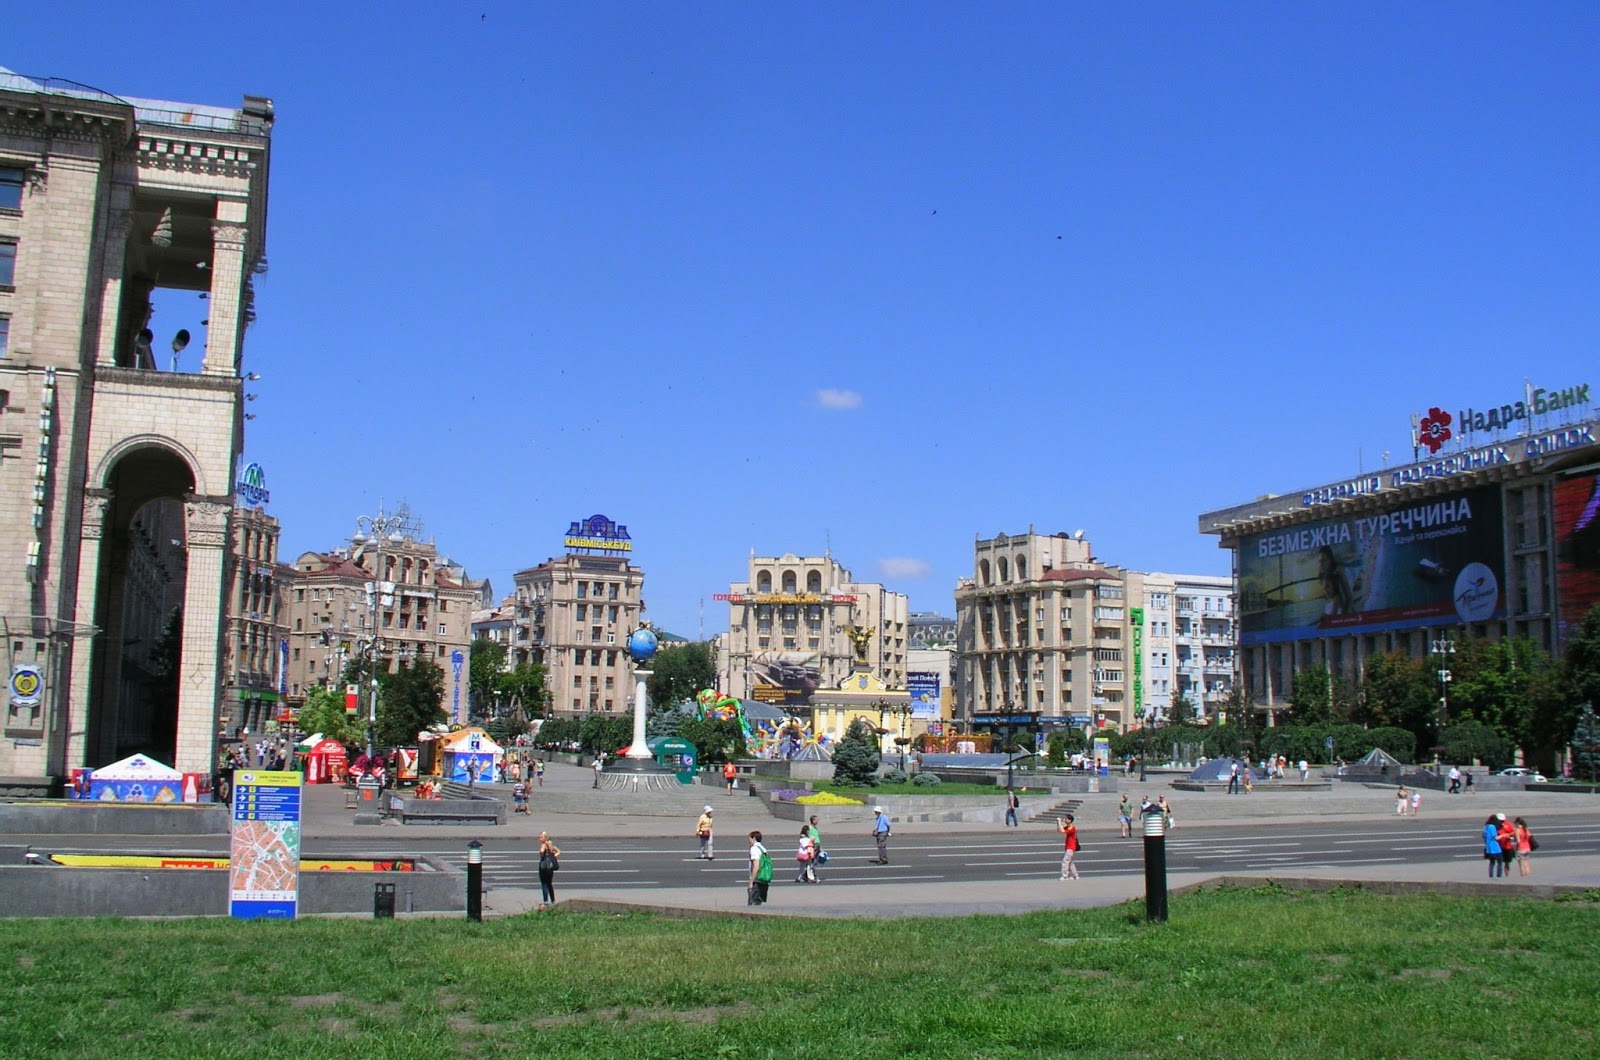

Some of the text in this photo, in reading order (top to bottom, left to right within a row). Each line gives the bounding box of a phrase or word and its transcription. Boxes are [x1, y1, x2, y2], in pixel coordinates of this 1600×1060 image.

[1459, 383, 1591, 434] Надра Банк
[1258, 497, 1472, 558] БЕЗМЕЖНА ТУРЕЧЧИНА
